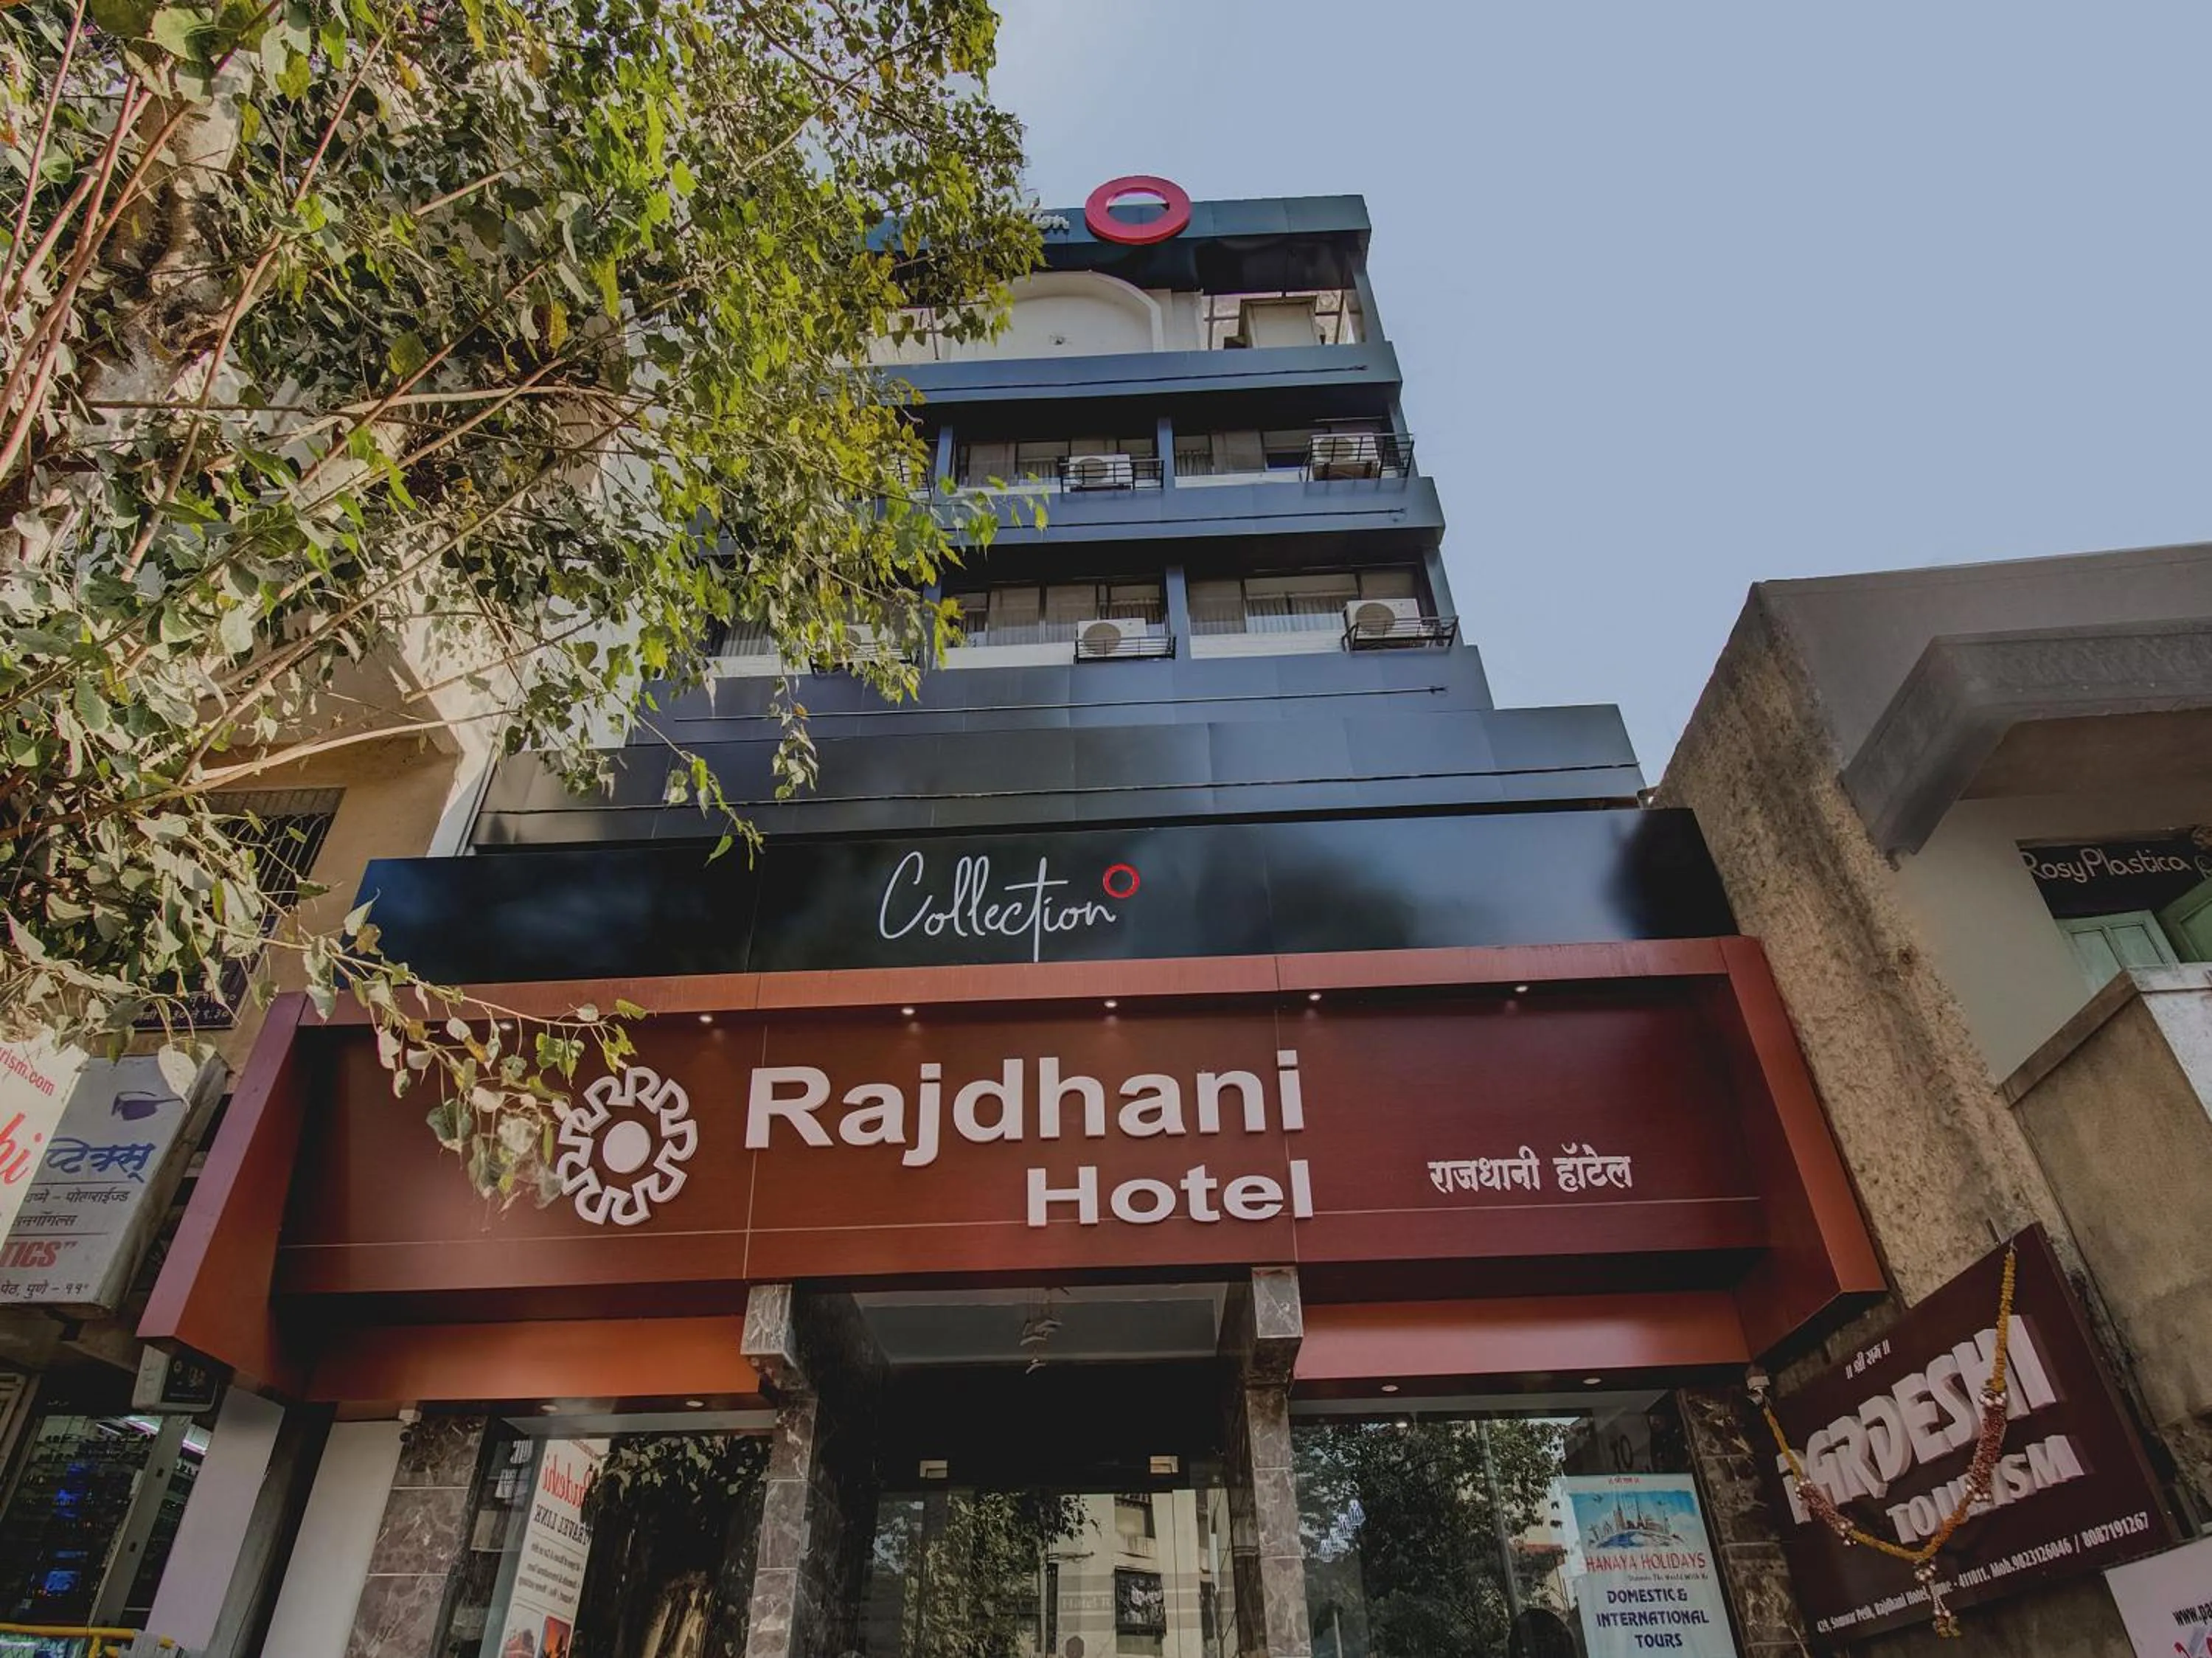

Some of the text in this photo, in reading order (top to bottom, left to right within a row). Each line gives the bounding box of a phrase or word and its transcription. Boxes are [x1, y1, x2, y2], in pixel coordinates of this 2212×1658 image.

[879, 851, 1116, 962] Collection
[0, 1047, 55, 1097] rism.com
[745, 1050, 1306, 1168] Rajdhani
[1427, 1142, 1632, 1193] राजधानी हॉटेल
[1028, 1160, 1314, 1227] Hotel
[1641, 1552, 1706, 1570] HOLIDAYS
[1607, 1587, 1676, 1604] DOMESTIC
[2171, 1601, 2212, 1628] www.pa
[1596, 1609, 1709, 1628] INTERNATIONAL
[1635, 1632, 1683, 1648] TOURS
